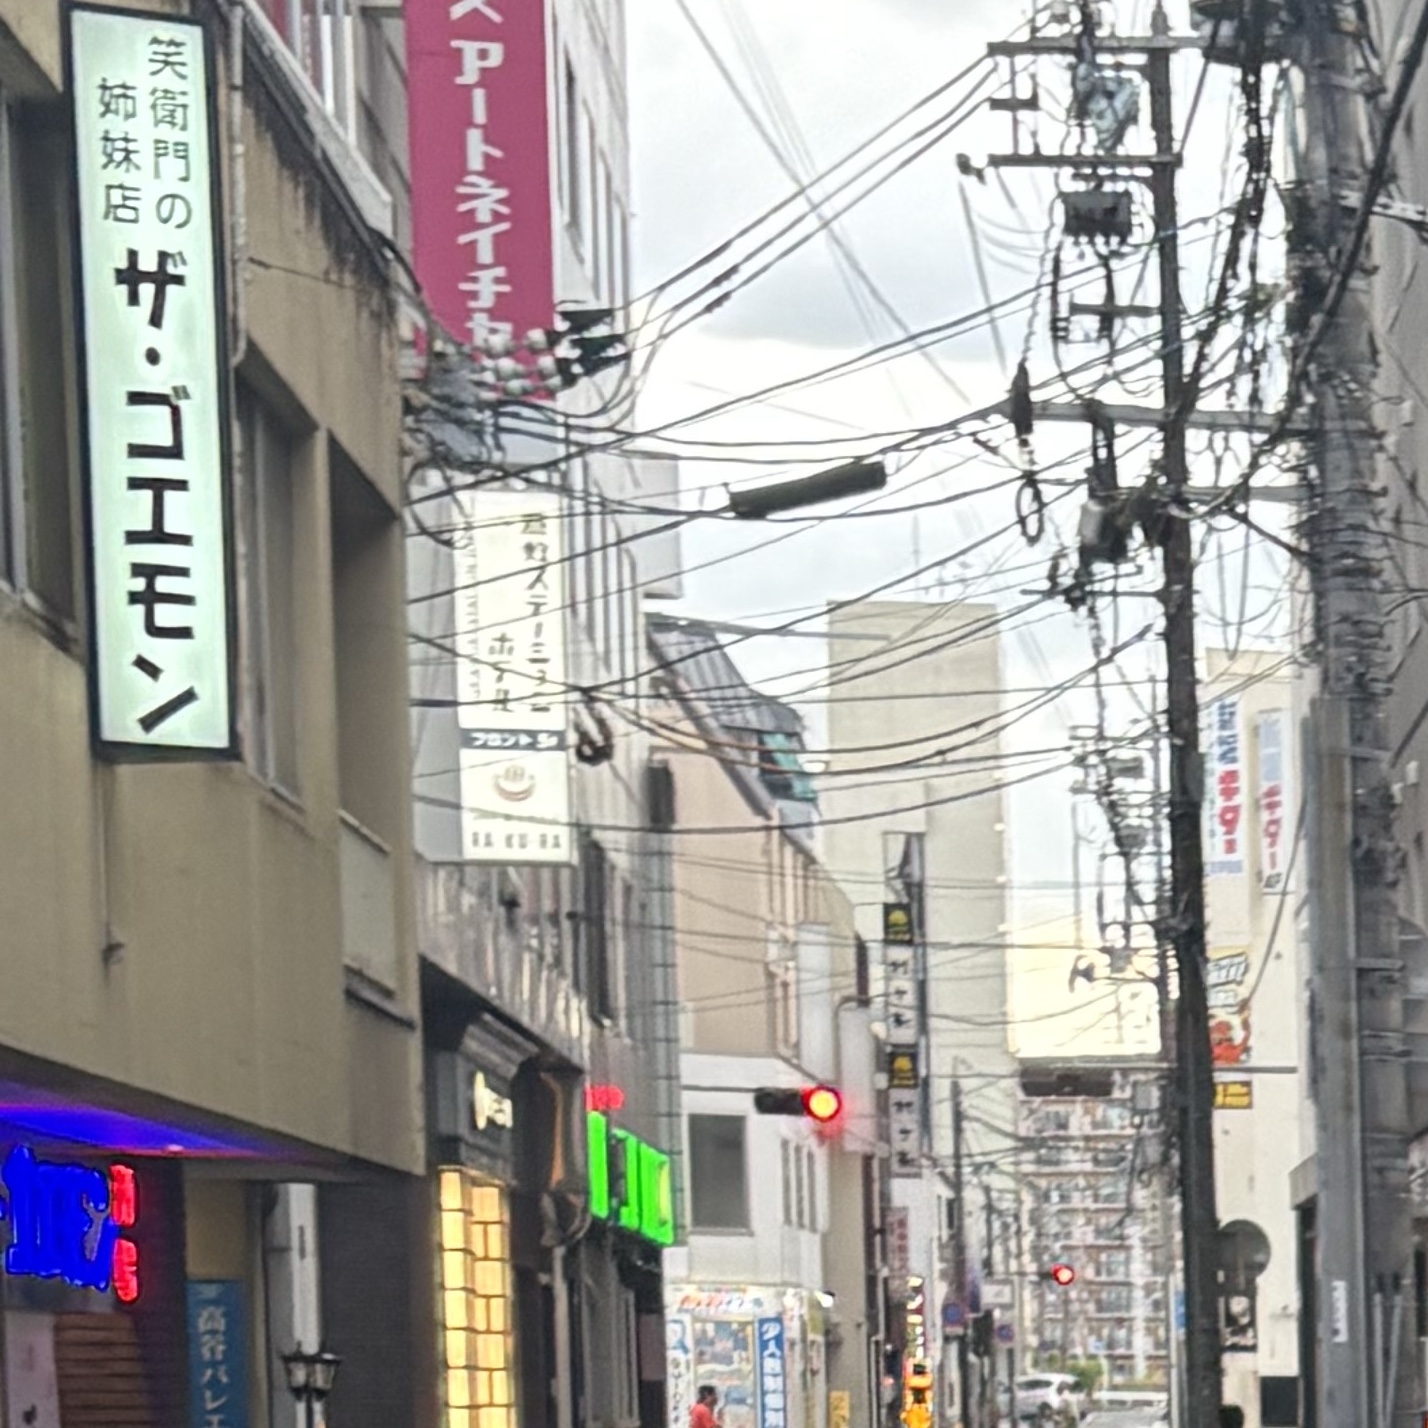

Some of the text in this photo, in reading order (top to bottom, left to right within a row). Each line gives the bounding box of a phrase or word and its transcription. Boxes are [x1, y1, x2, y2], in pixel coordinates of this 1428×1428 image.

[97, 77, 141, 225] 姉妹店
[148, 36, 192, 229] 笑衛門の
[114, 249, 199, 733] ザ・ゴエモン
